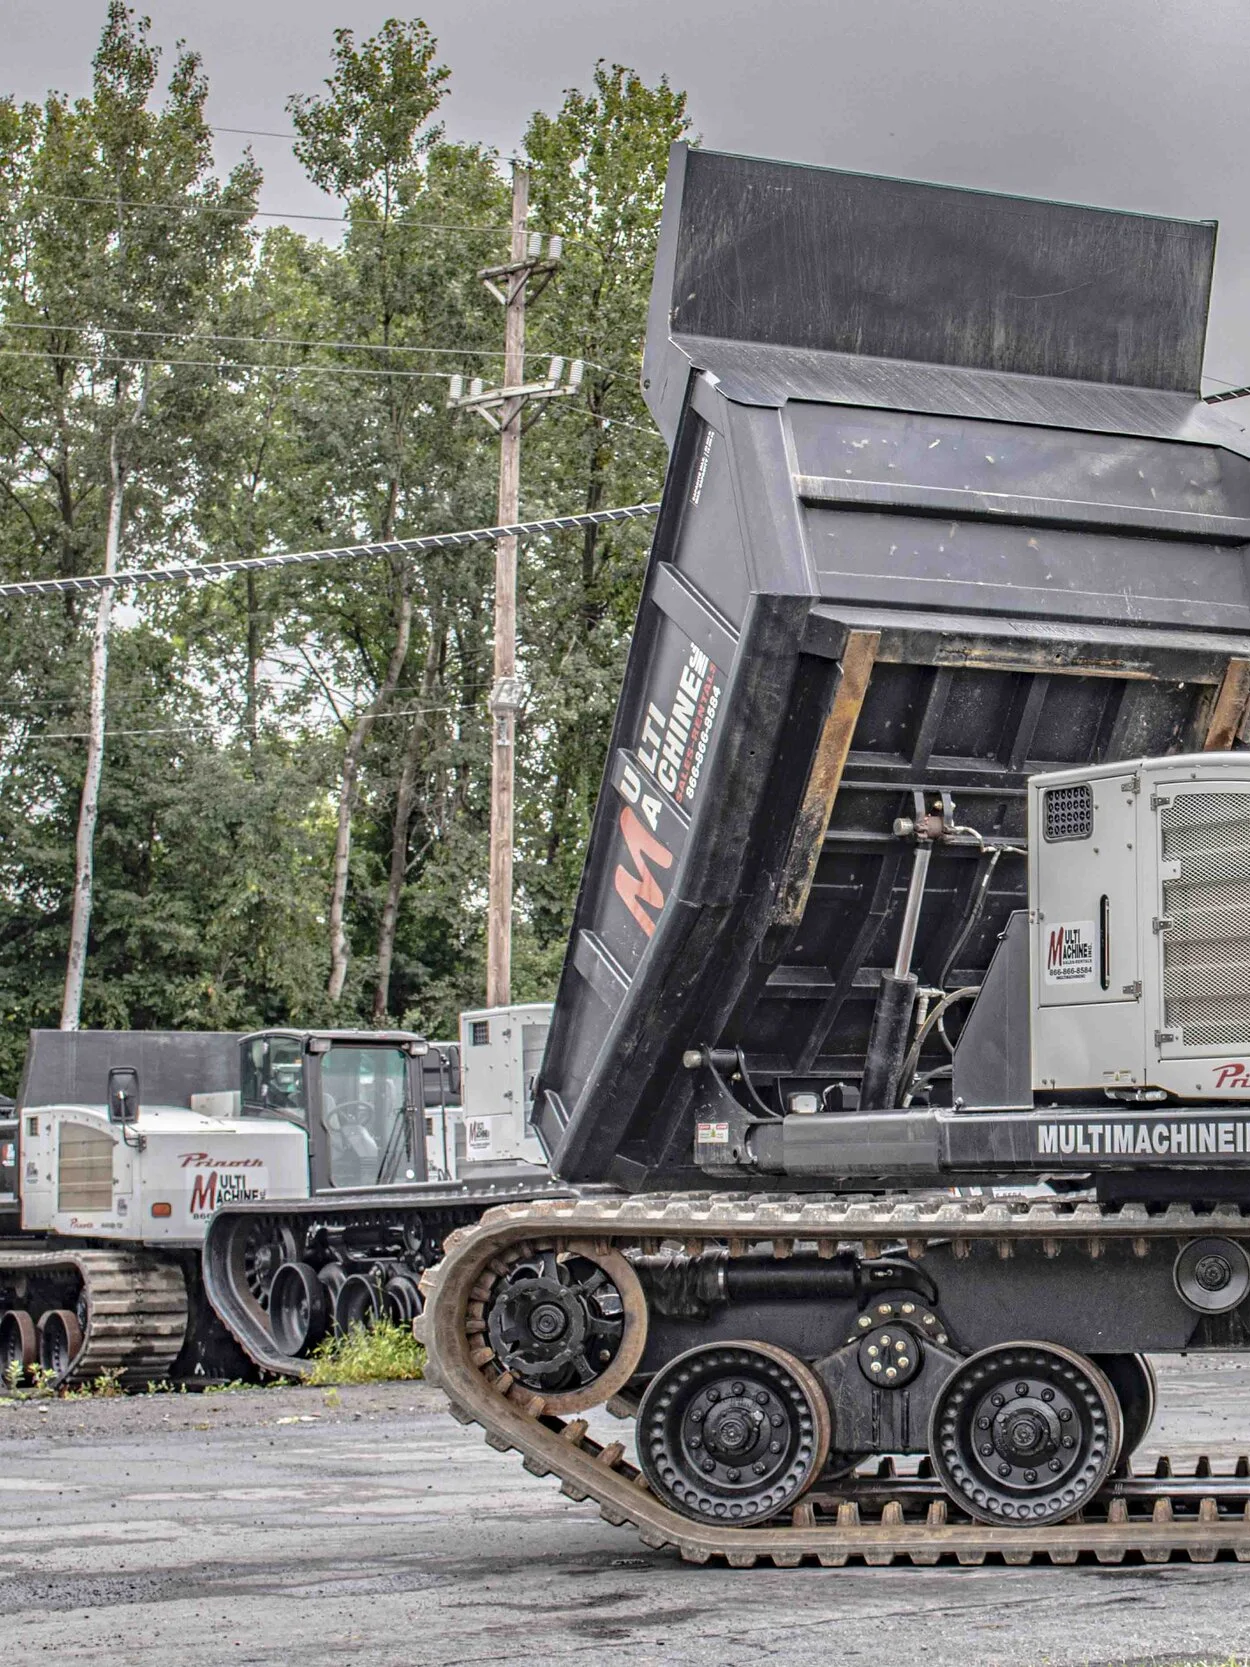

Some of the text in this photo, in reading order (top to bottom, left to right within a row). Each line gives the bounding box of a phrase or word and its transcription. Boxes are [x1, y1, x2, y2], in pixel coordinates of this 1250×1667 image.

[685, 685, 722, 800] 866-866-8584
[1049, 966, 1093, 976] 866-866-8584
[177, 1152, 263, 1168] Prinoth
